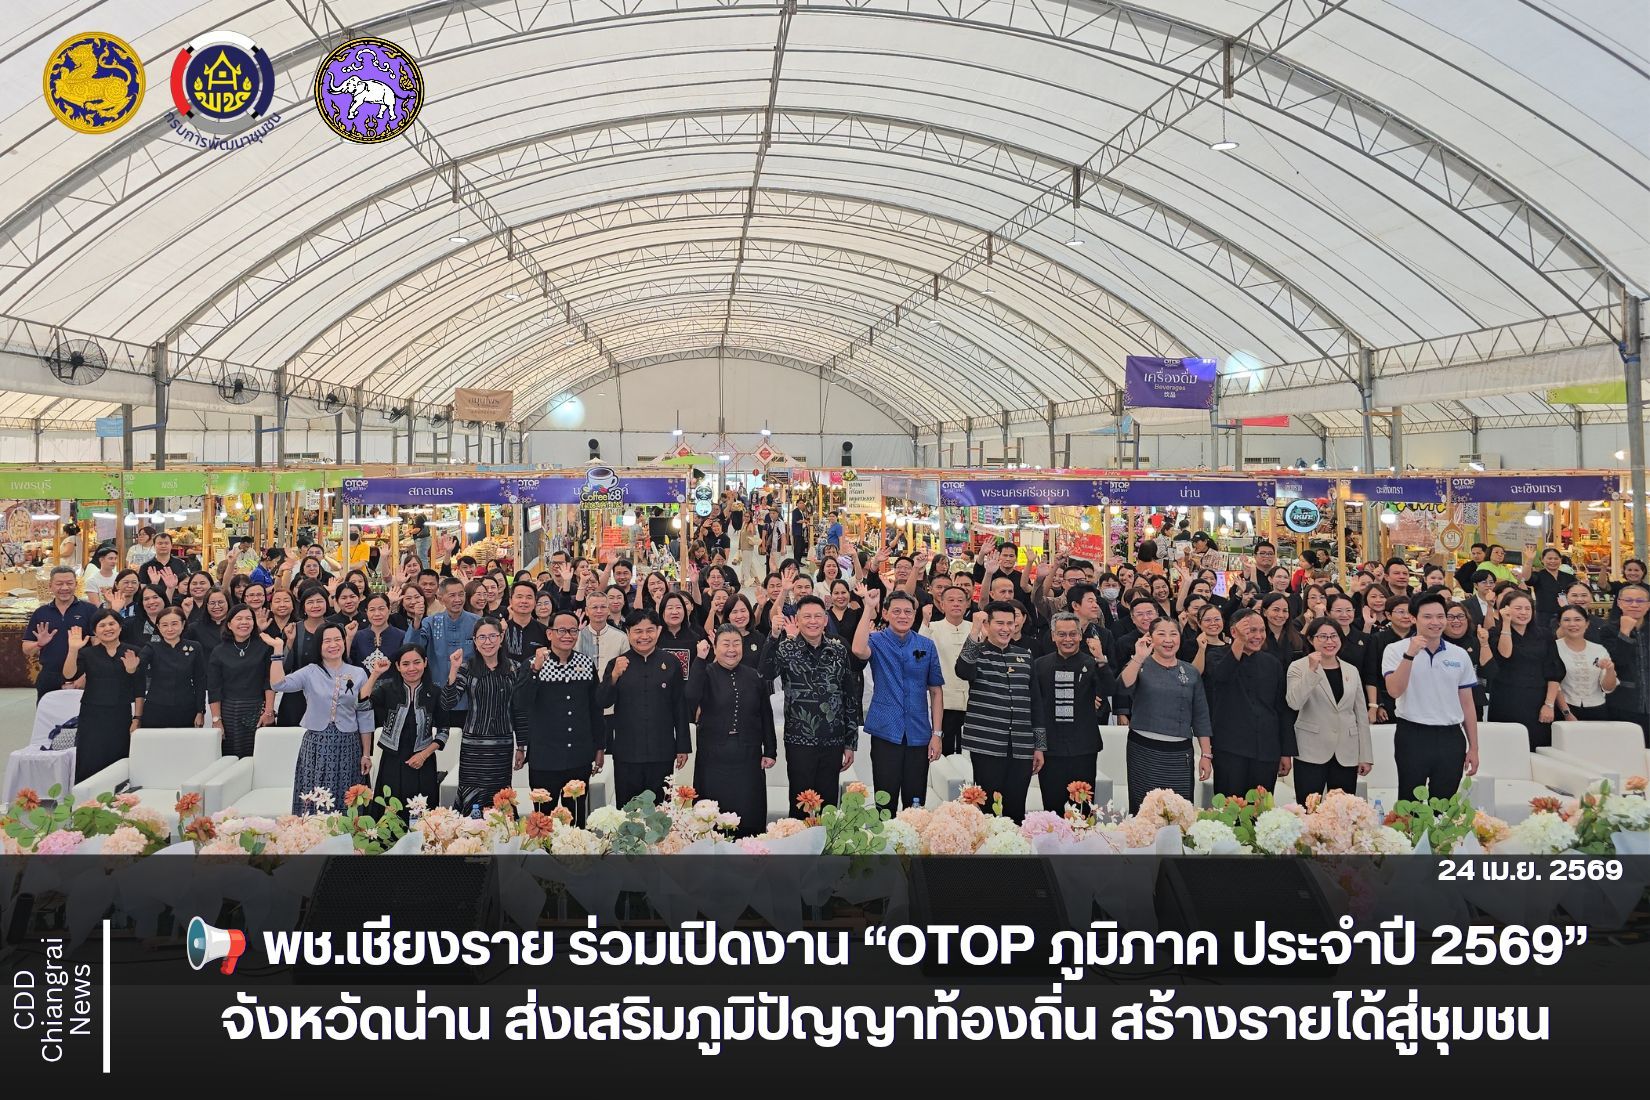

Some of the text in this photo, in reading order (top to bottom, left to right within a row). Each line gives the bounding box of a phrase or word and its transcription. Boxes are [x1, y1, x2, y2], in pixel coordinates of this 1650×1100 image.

[1144, 367, 1198, 384] เครื่องดื่ม
[1154, 383, 1186, 392] Beverages
[345, 479, 369, 487] OTOP
[942, 481, 965, 489] OTOP
[1452, 478, 1476, 486] OTOP
[408, 486, 454, 496] สกลนคร
[981, 486, 1070, 501] พระนครศรีอยุธยา
[1180, 485, 1200, 498] น่าน
[1375, 484, 1404, 495] ฉะเชิงเทรา
[1510, 483, 1562, 494] ฉะเชิงเทรา
